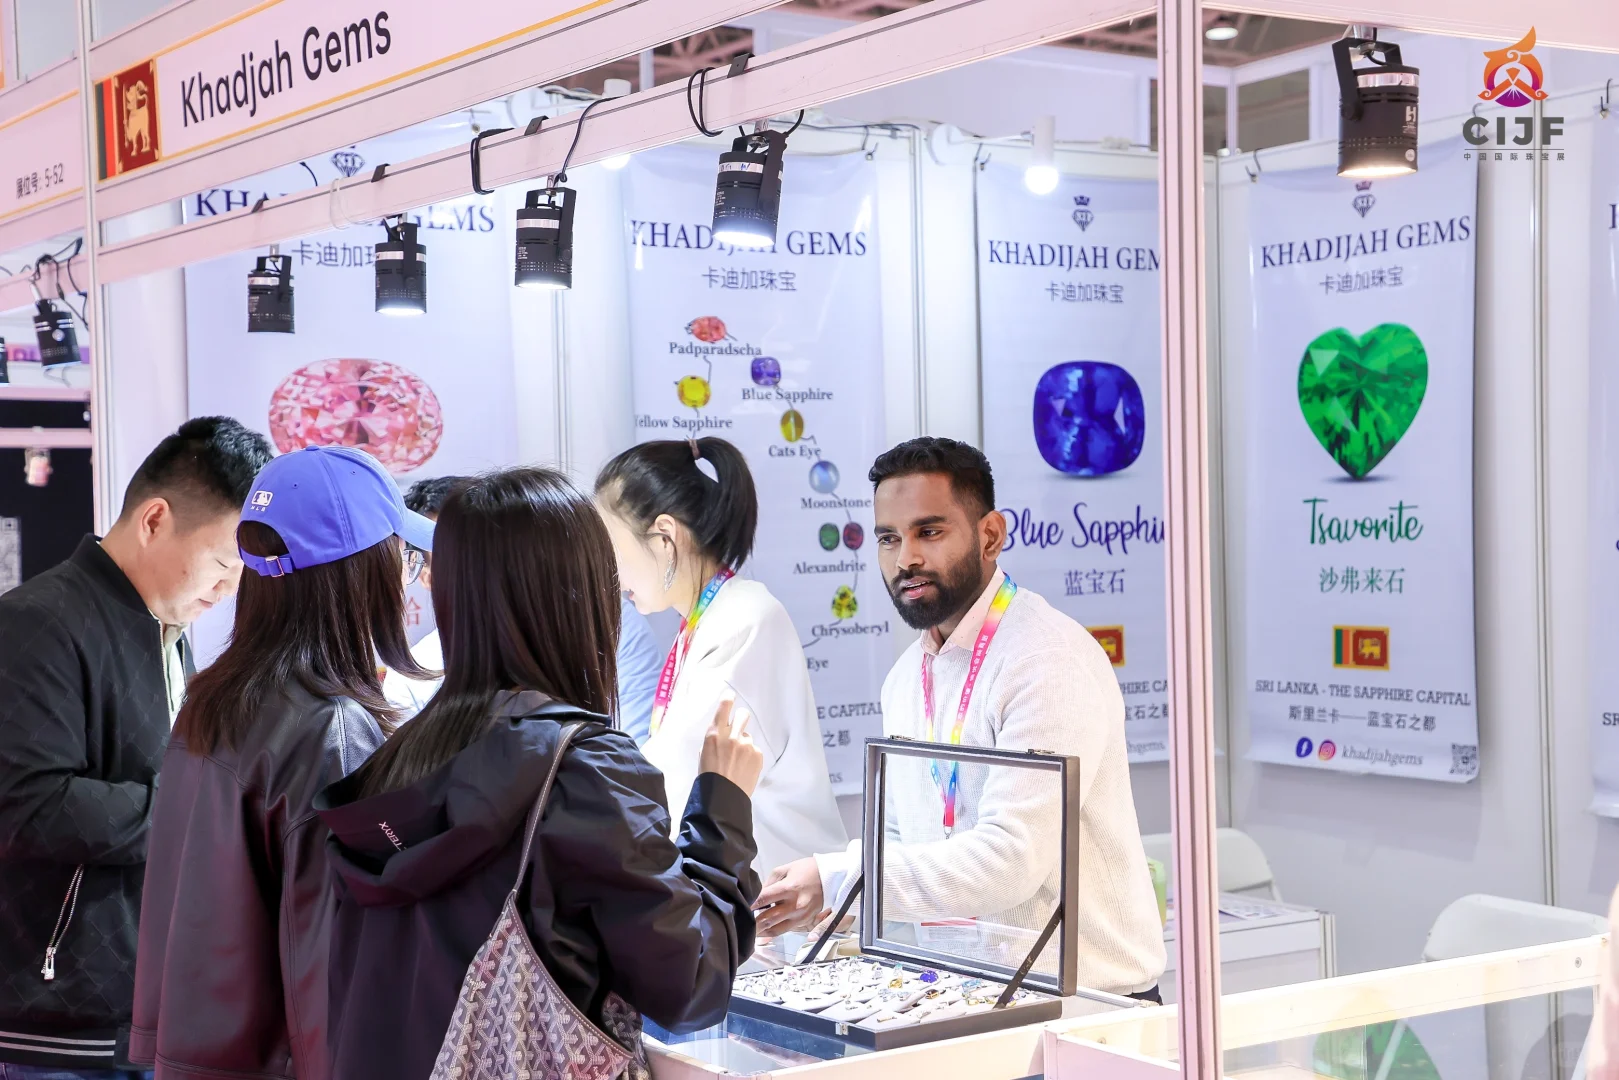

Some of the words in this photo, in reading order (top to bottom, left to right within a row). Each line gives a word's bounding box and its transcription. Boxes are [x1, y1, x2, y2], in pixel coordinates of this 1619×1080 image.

[181, 39, 293, 128] Khadjah
[302, 11, 392, 81] Gems
[786, 230, 867, 256] GEMS
[988, 239, 1109, 272] KHADIJAH
[1260, 228, 1389, 269] KHADIJAH
[1396, 216, 1472, 250] GEMS
[701, 266, 798, 292] 卡迪加珠宝
[1045, 280, 1124, 304] 卡迪加珠宝
[1318, 266, 1404, 296] 卡迪加珠宝
[668, 341, 762, 356] Padparadscha
[742, 388, 772, 400] Blue
[775, 388, 834, 403] Sapphire
[672, 416, 732, 430] Sapphire
[768, 445, 796, 458] Cats
[798, 446, 822, 460] Eye
[801, 497, 872, 510] Moonstone
[1302, 497, 1424, 546] Tsavorite
[793, 560, 867, 575] Alexandrite
[1318, 566, 1407, 595] 沙弗来石
[1064, 568, 1126, 597] 蓝宝石
[811, 621, 890, 639] Chrysoberyl
[1255, 679, 1274, 693] SRI
[1277, 680, 1319, 697] LANKA
[1328, 684, 1352, 699] THE
[1353, 685, 1414, 703] SAPPHIRE
[1415, 689, 1472, 707] CAPITAL
